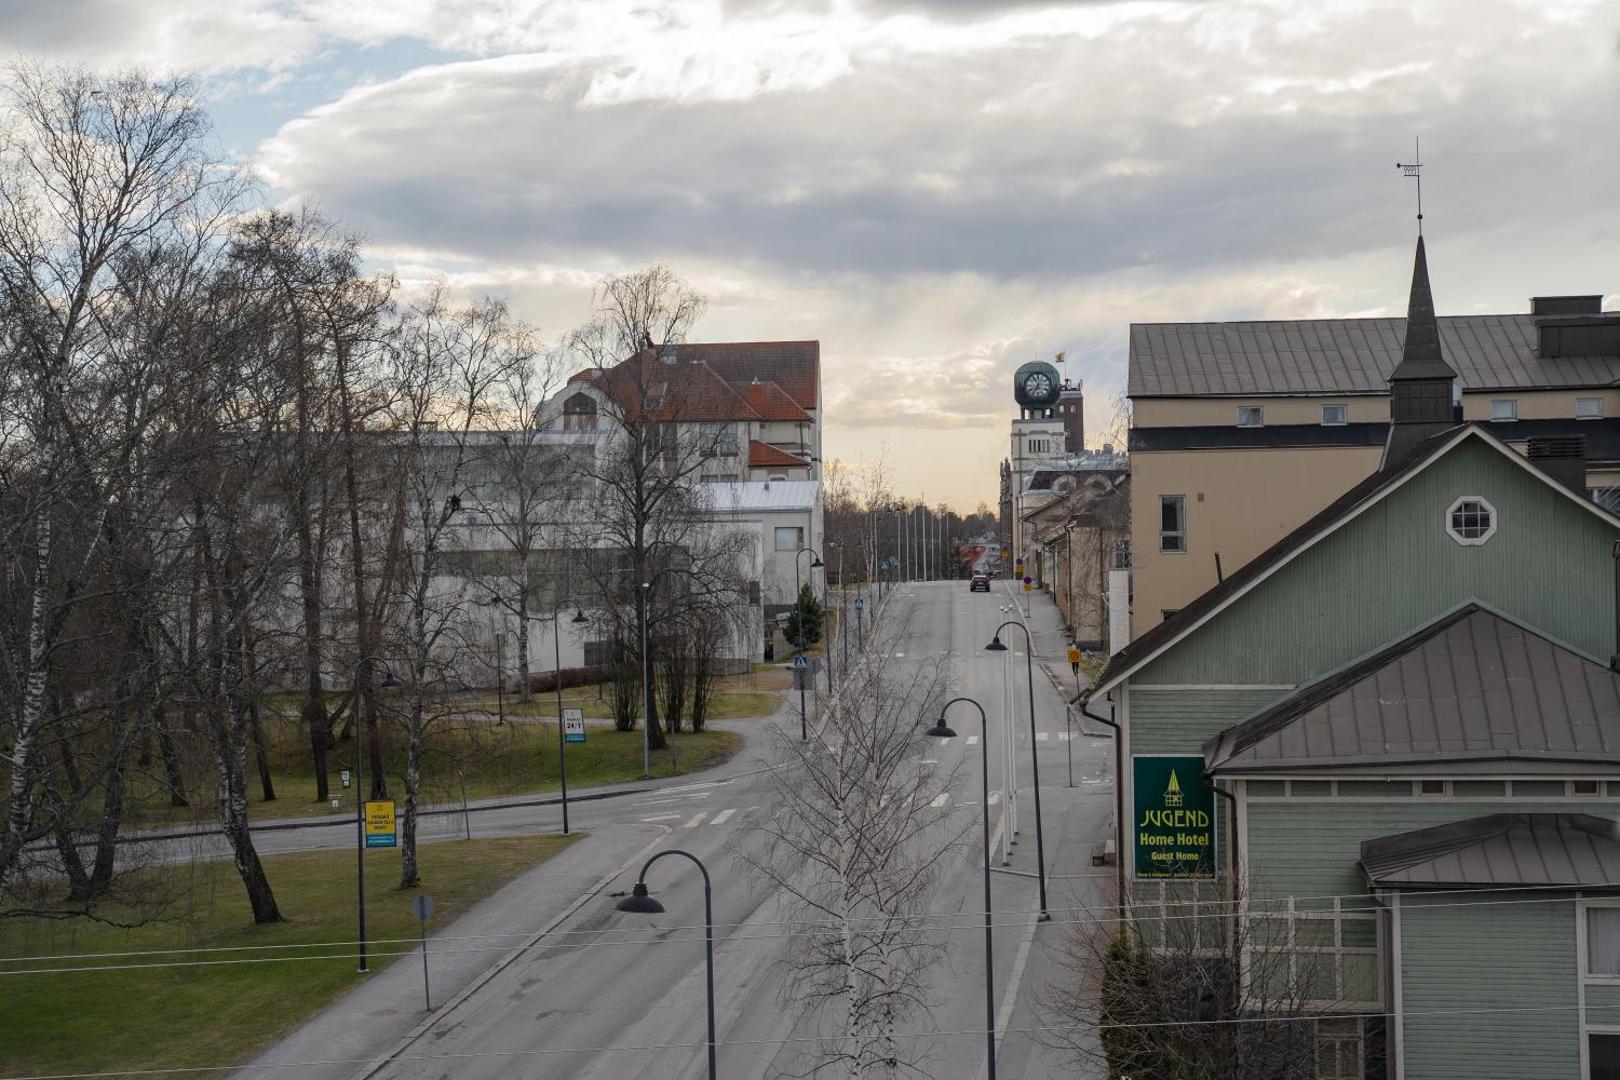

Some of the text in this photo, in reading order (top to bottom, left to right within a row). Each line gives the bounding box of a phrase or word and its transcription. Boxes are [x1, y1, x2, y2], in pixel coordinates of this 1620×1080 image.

[1140, 809, 1209, 827] JUGEND
[1140, 832, 1209, 846] Home Hotel
[1151, 851, 1200, 861] Guest Home
